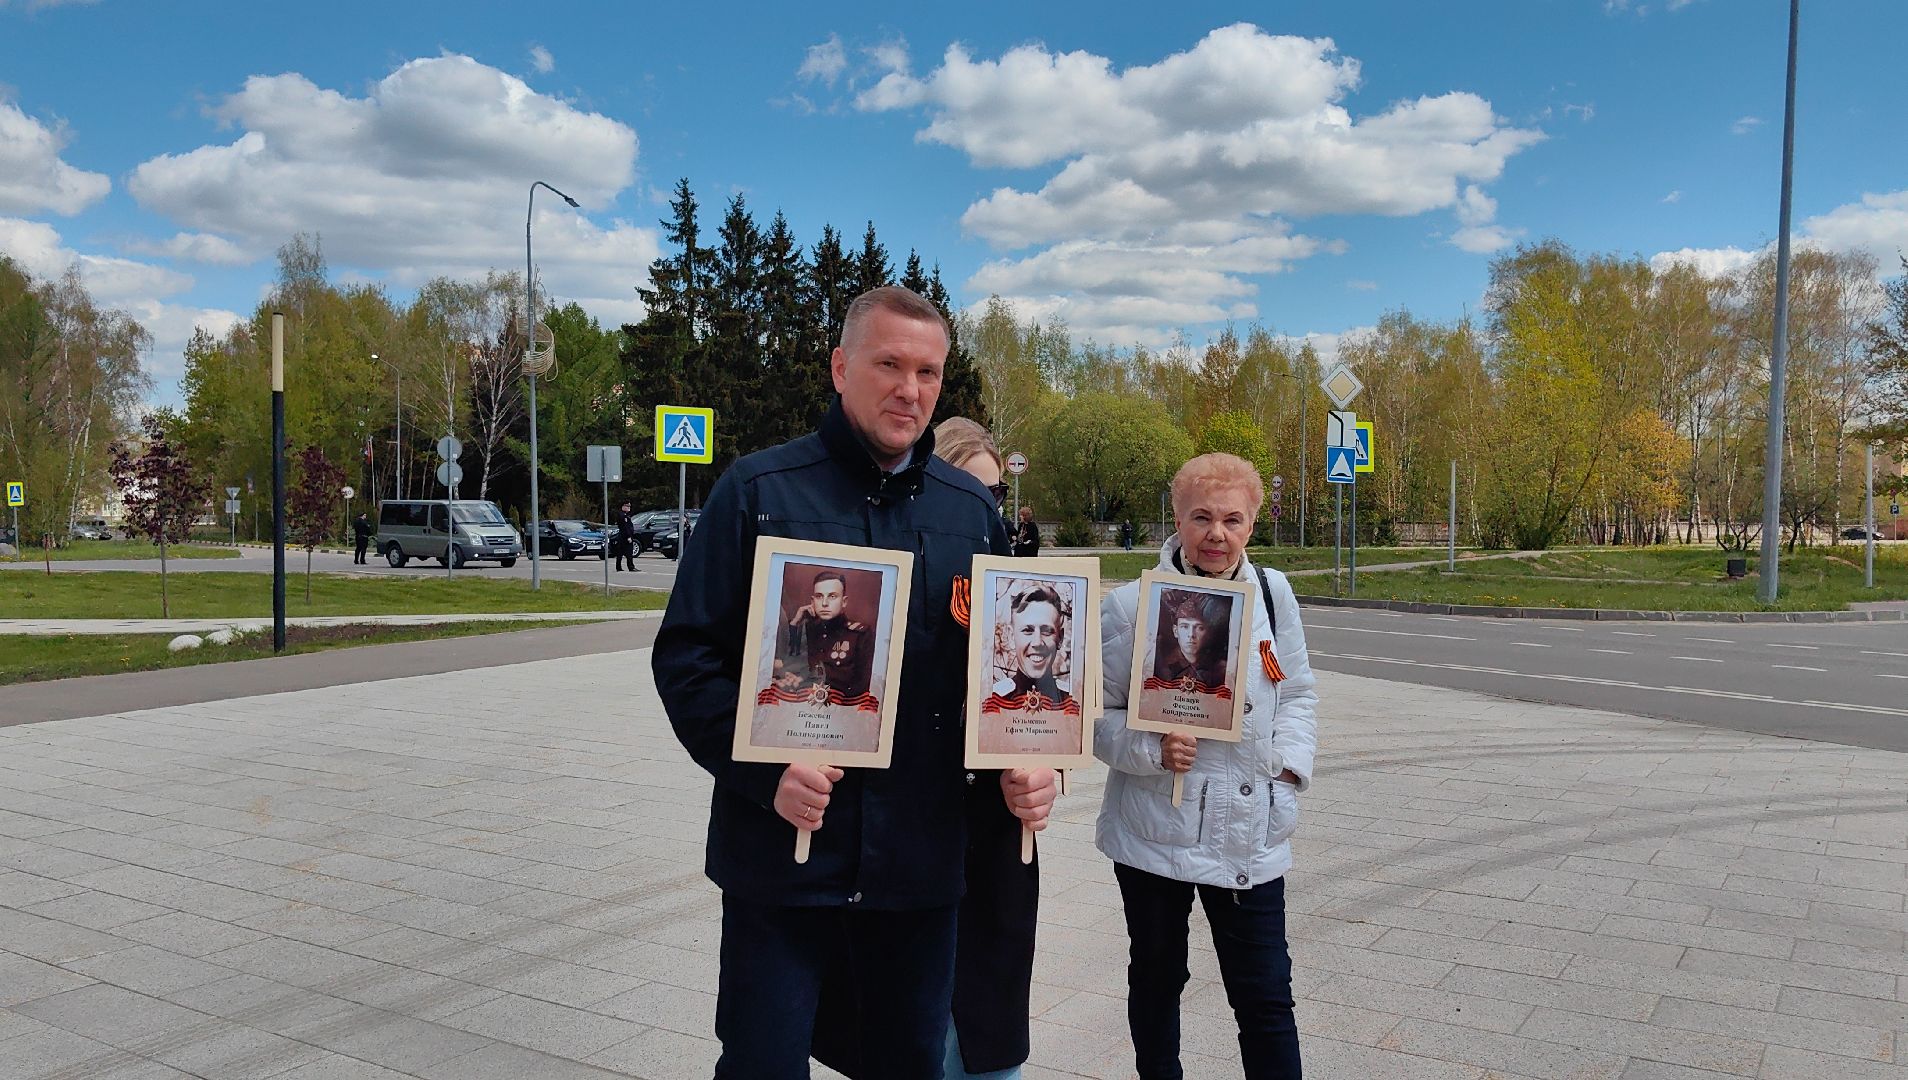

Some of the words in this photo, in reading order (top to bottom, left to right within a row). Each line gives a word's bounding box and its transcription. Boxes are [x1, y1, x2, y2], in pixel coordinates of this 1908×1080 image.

[805, 721, 829, 729] Павел
[1012, 717, 1047, 725] Кузьменко
[786, 729, 844, 739] Поликарпович
[1005, 726, 1023, 735] Ефим
[1025, 727, 1058, 735] Маркович
